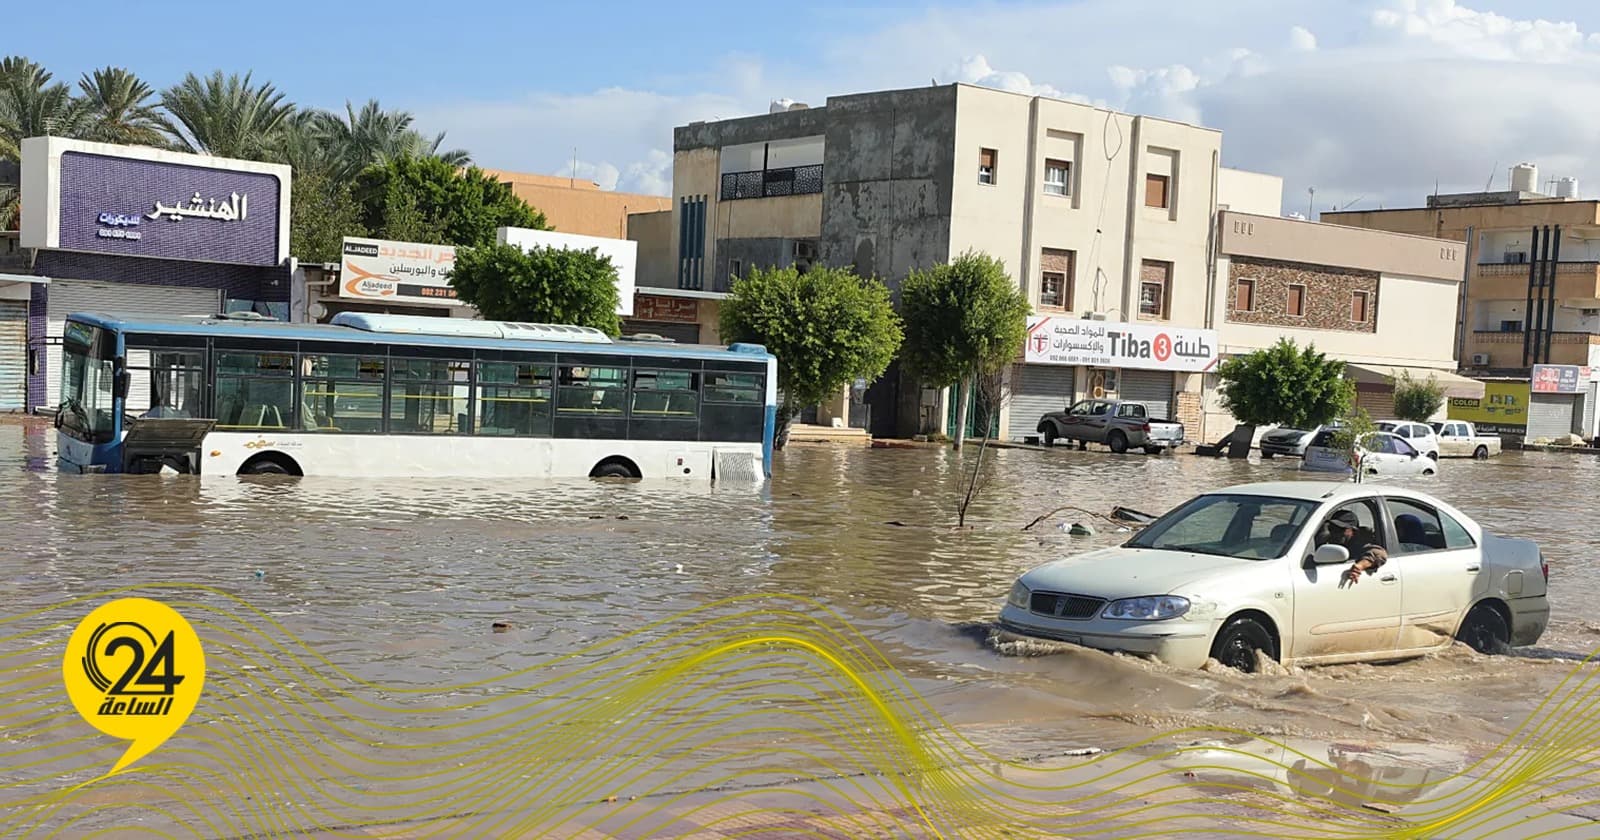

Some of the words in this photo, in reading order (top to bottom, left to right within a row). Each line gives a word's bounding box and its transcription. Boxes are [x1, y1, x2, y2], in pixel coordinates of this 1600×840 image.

[146, 191, 247, 220] الهنشير
[345, 245, 377, 255] ALJADEED
[362, 281, 392, 289] Aljadeed
[1054, 324, 1080, 335] الصحية
[1081, 325, 1104, 339] للمواد
[1107, 332, 1150, 358] Tiba
[1174, 335, 1210, 362] طيبة
